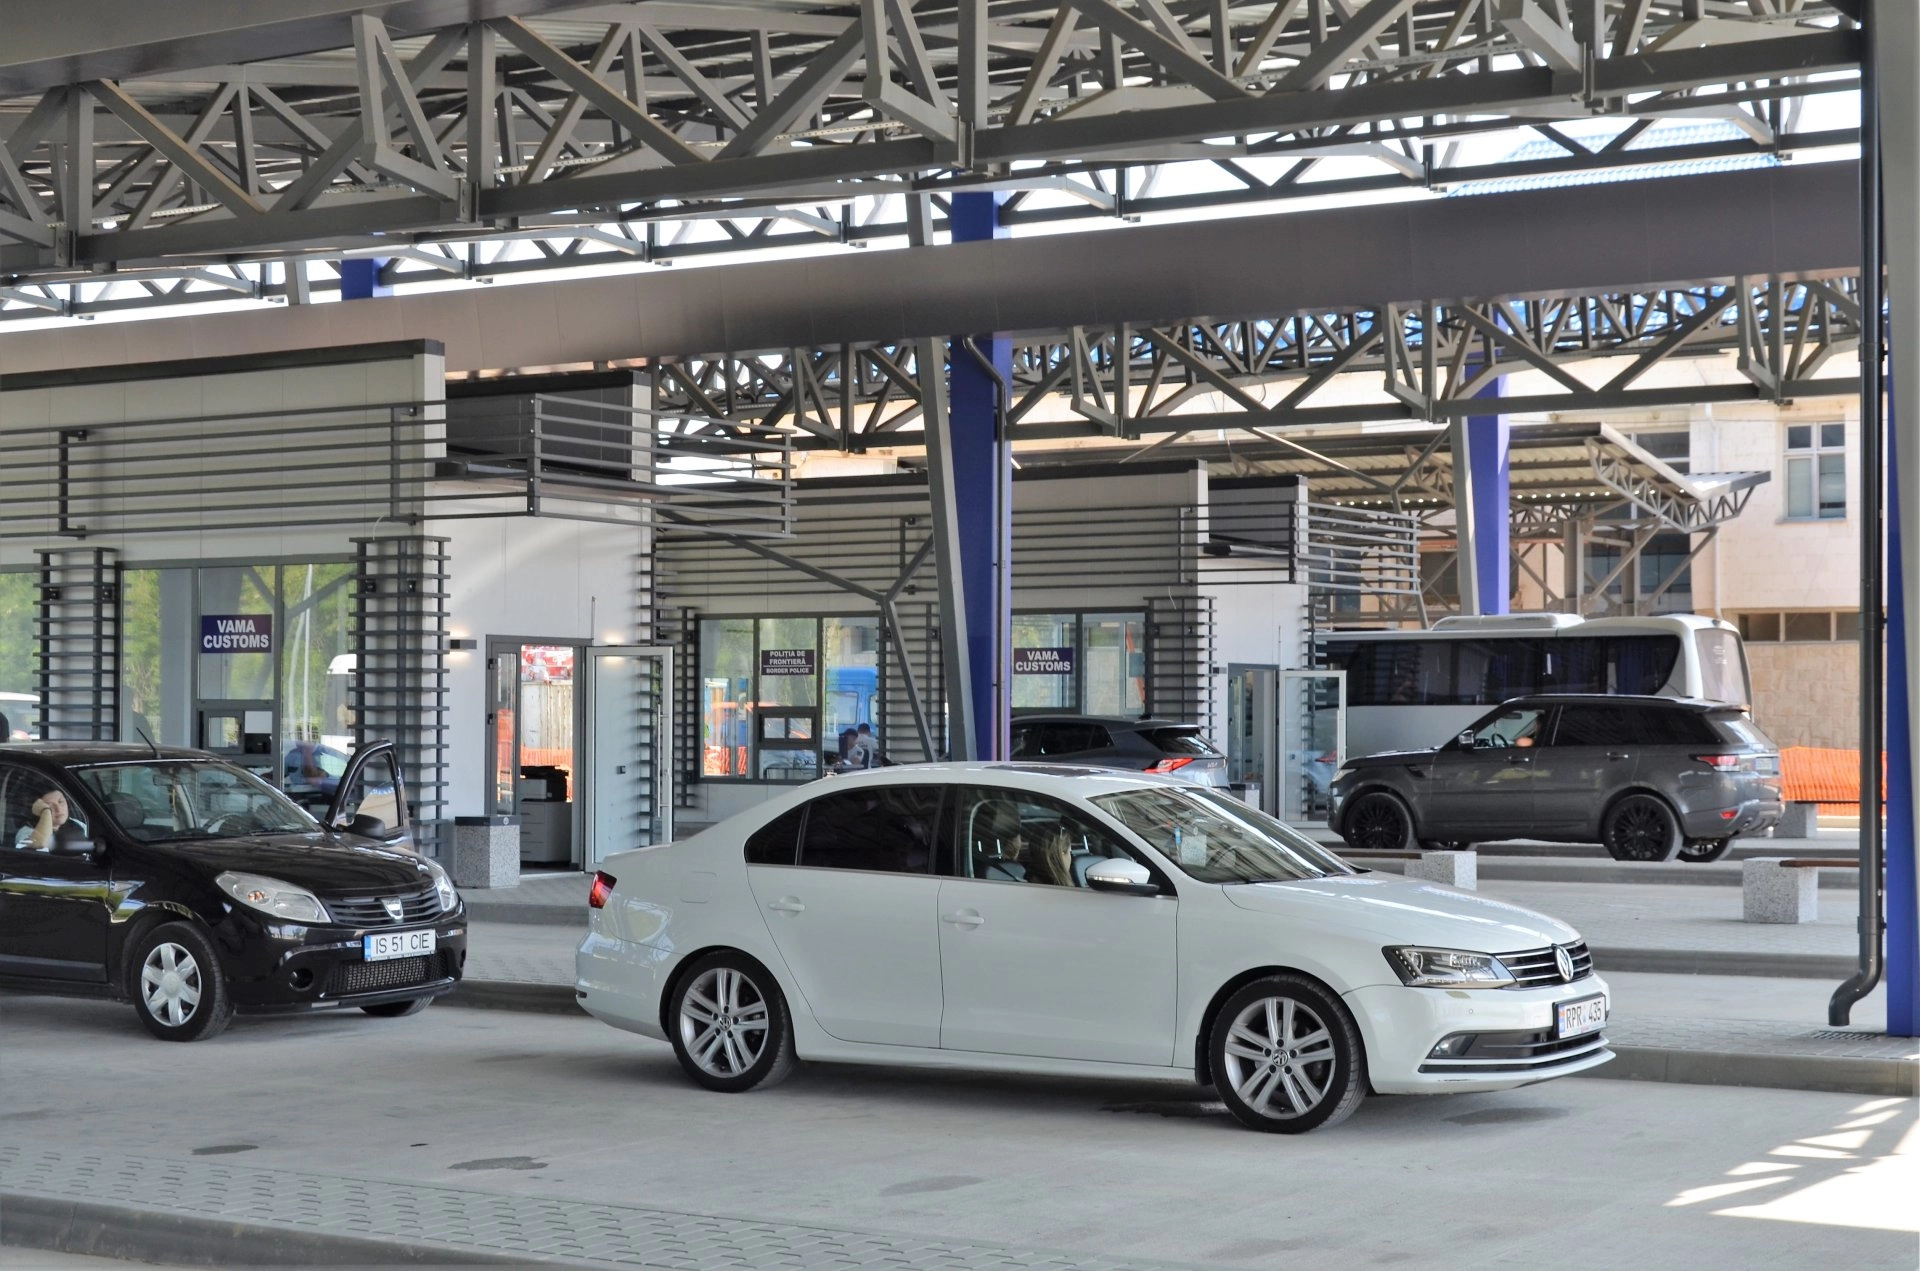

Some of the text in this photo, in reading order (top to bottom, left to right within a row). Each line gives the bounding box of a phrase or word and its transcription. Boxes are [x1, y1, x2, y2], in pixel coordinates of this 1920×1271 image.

[216, 619, 256, 633] VAMA
[203, 634, 269, 649] CUSTOMS
[1026, 650, 1060, 661] VAMA
[1015, 661, 1071, 672] CUSTOMS
[375, 932, 430, 954] IS 51 CIE
[1566, 1005, 1582, 1029] RPR
[1588, 1001, 1602, 1023] 435
